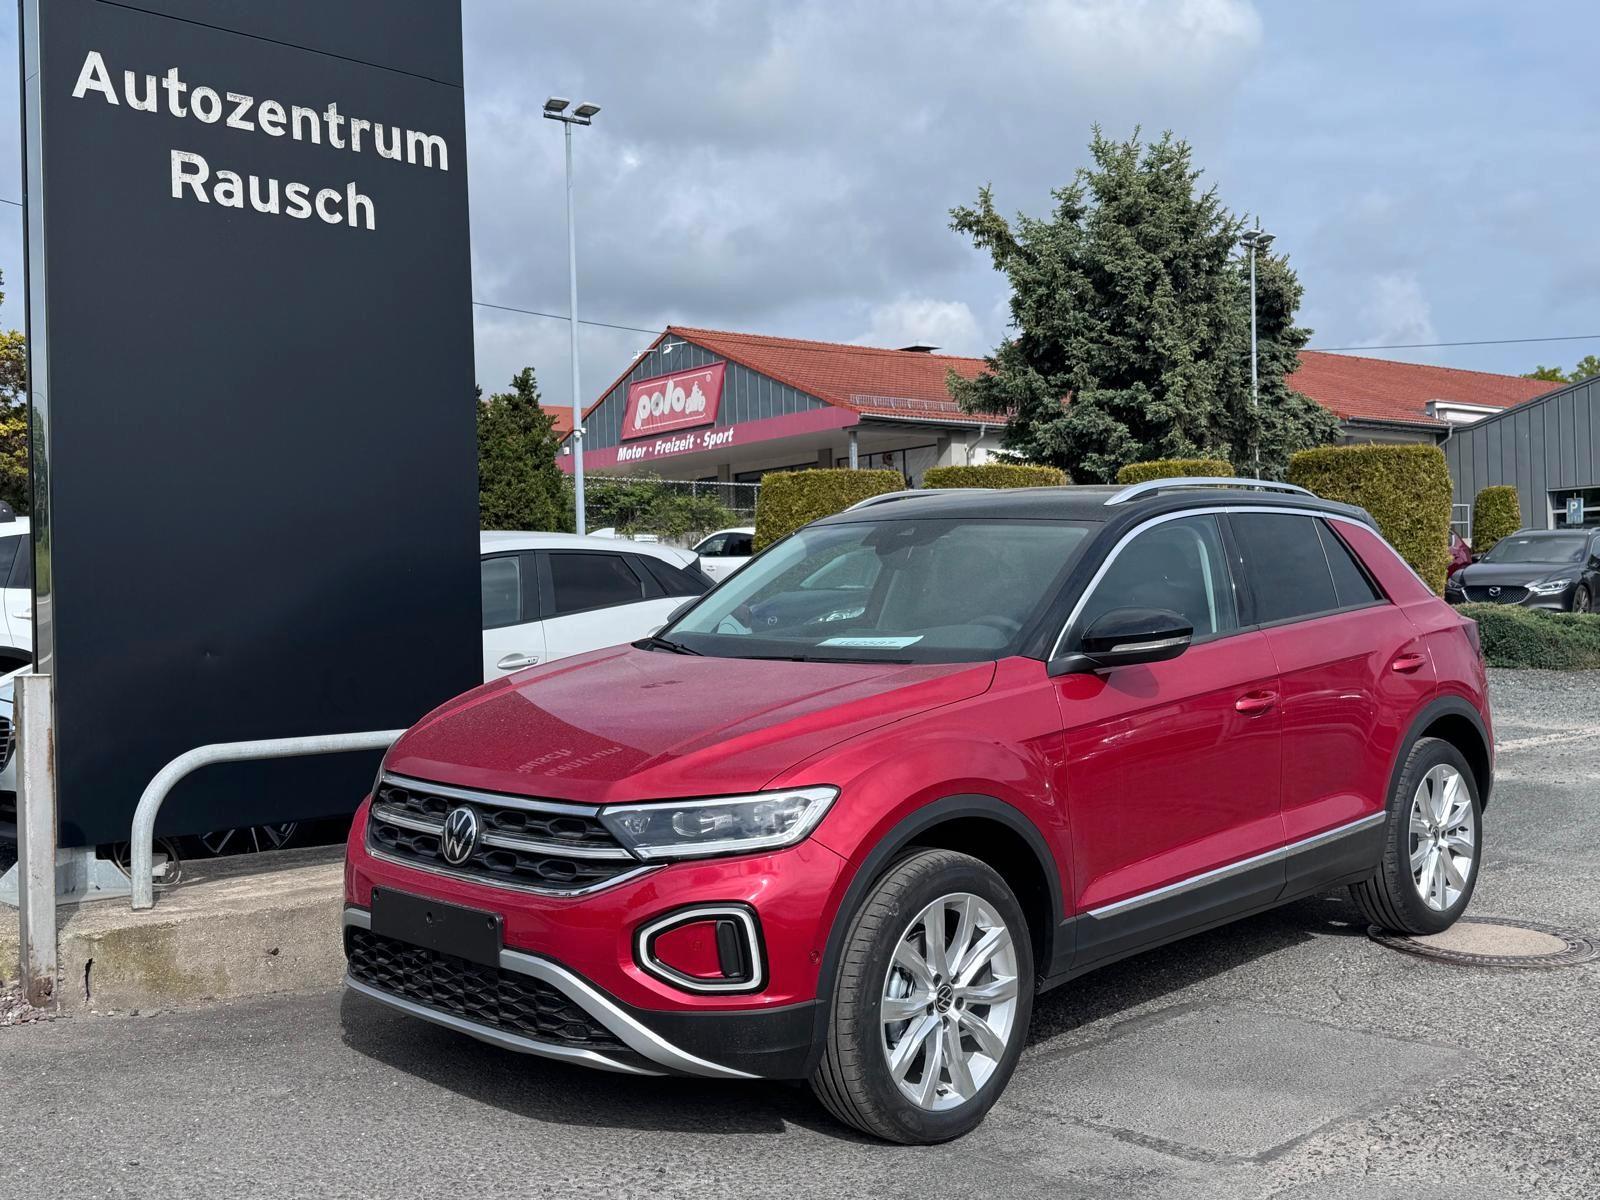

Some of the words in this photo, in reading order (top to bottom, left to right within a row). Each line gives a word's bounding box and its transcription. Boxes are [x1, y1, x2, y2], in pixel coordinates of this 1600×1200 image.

[72, 50, 448, 171] Autozentrum
[170, 148, 377, 231] Rausch
[634, 379, 685, 430] polo
[617, 445, 646, 461] Motor
[655, 435, 694, 455] Freizeit
[703, 427, 734, 449] Sport
[1570, 501, 1578, 513] P
